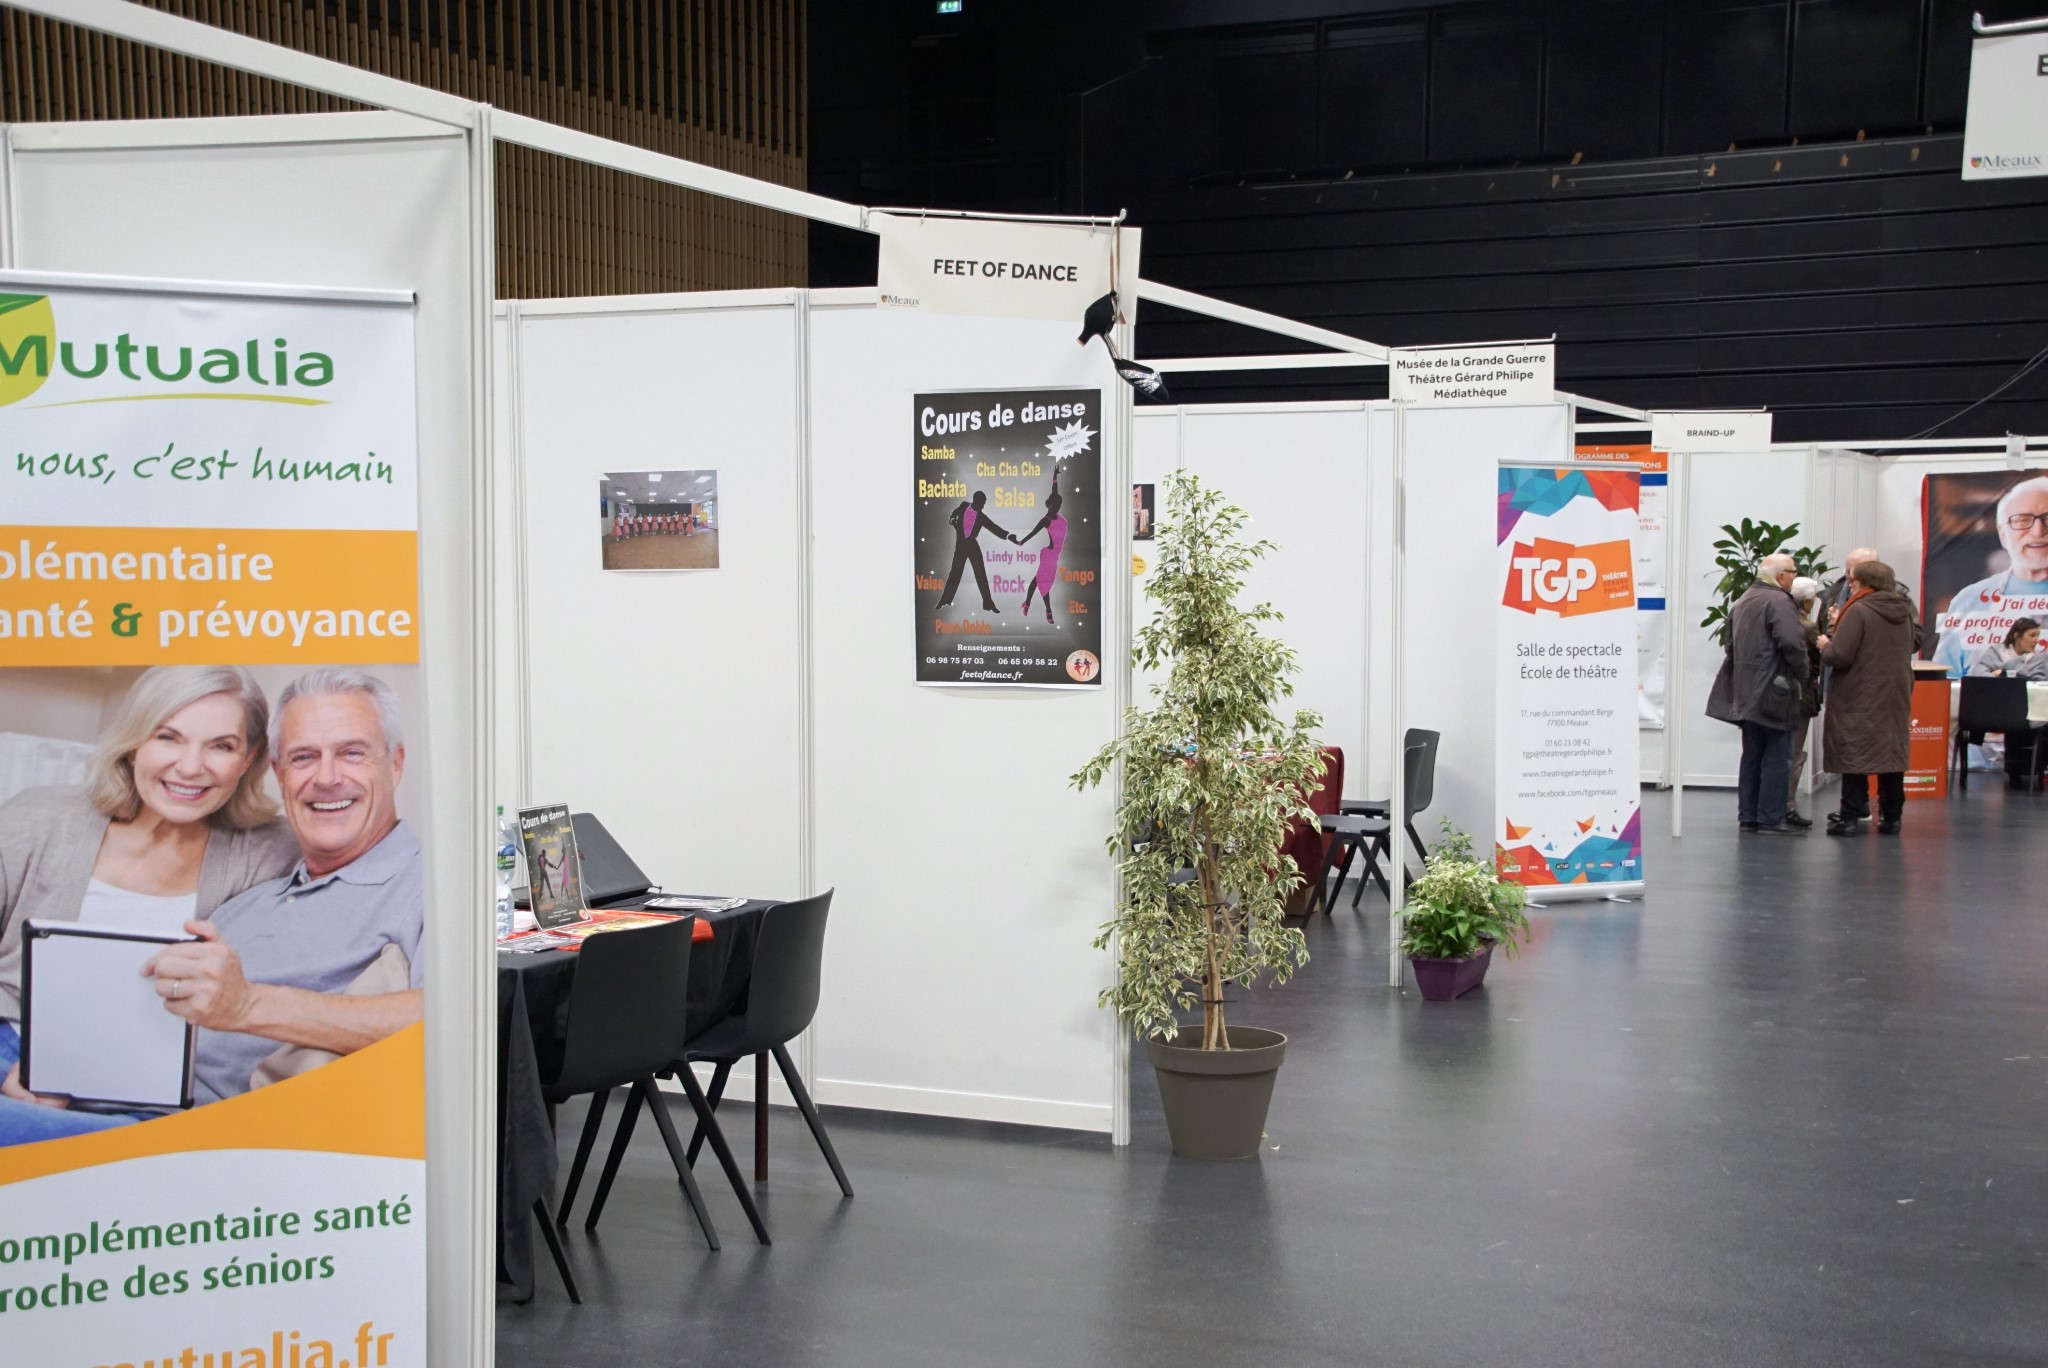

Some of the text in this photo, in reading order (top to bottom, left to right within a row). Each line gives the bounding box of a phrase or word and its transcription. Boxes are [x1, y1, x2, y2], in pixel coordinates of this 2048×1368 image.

[1983, 155, 2041, 167] Meaux
[934, 259, 1077, 282] FEET OF DANCE
[888, 295, 920, 305] Meaux
[0, 333, 334, 387] Mutualia
[1396, 354, 1546, 369] Musée de la Grande Guerre
[1408, 370, 1534, 384] Théâtre Gérard Philipe
[1434, 388, 1507, 399] Médiathèque
[921, 402, 1086, 437] Cours de danse
[1687, 429, 1735, 437] BRAIND-UP
[921, 445, 955, 460] Samba
[17, 442, 393, 485] nous, c'est humain
[977, 461, 1041, 477] Cha Cha Cha
[918, 479, 967, 498] Bachata
[994, 487, 1035, 508] Salsa
[986, 551, 1037, 565] Lindy Hop
[916, 575, 944, 590] Valse
[993, 575, 1026, 593] Rock
[1059, 567, 1095, 586] Tango
[1513, 557, 1597, 603] TGP
[1068, 600, 1088, 614] Etc.
[2029, 598, 2048, 609] dé
[111, 602, 143, 637] &
[159, 600, 412, 648] prévoyance
[1944, 616, 1960, 628] de
[1967, 633, 2001, 644] de la
[957, 644, 1021, 652] Renseignements
[1516, 643, 1622, 659] Salle de spectacle
[960, 671, 1023, 680] feetofdance.fr
[1520, 663, 1617, 679] École de théâtre
[1542, 709, 1550, 717] du
[1551, 709, 1595, 717] commandant
[1547, 719, 1566, 727] 77100
[1545, 738, 1591, 747] 01 60 23 08 42
[1522, 748, 1612, 759] tgp@theatregerardphilipe.fr
[1522, 768, 1614, 778] www.theatregerardphilipe.fr
[1518, 789, 1617, 798] www.facebook.com/tgpmeaux
[521, 810, 566, 829] Cours de danse
[314, 1194, 412, 1232] santé
[123, 1265, 189, 1298] des
[203, 1252, 335, 1290] séniors
